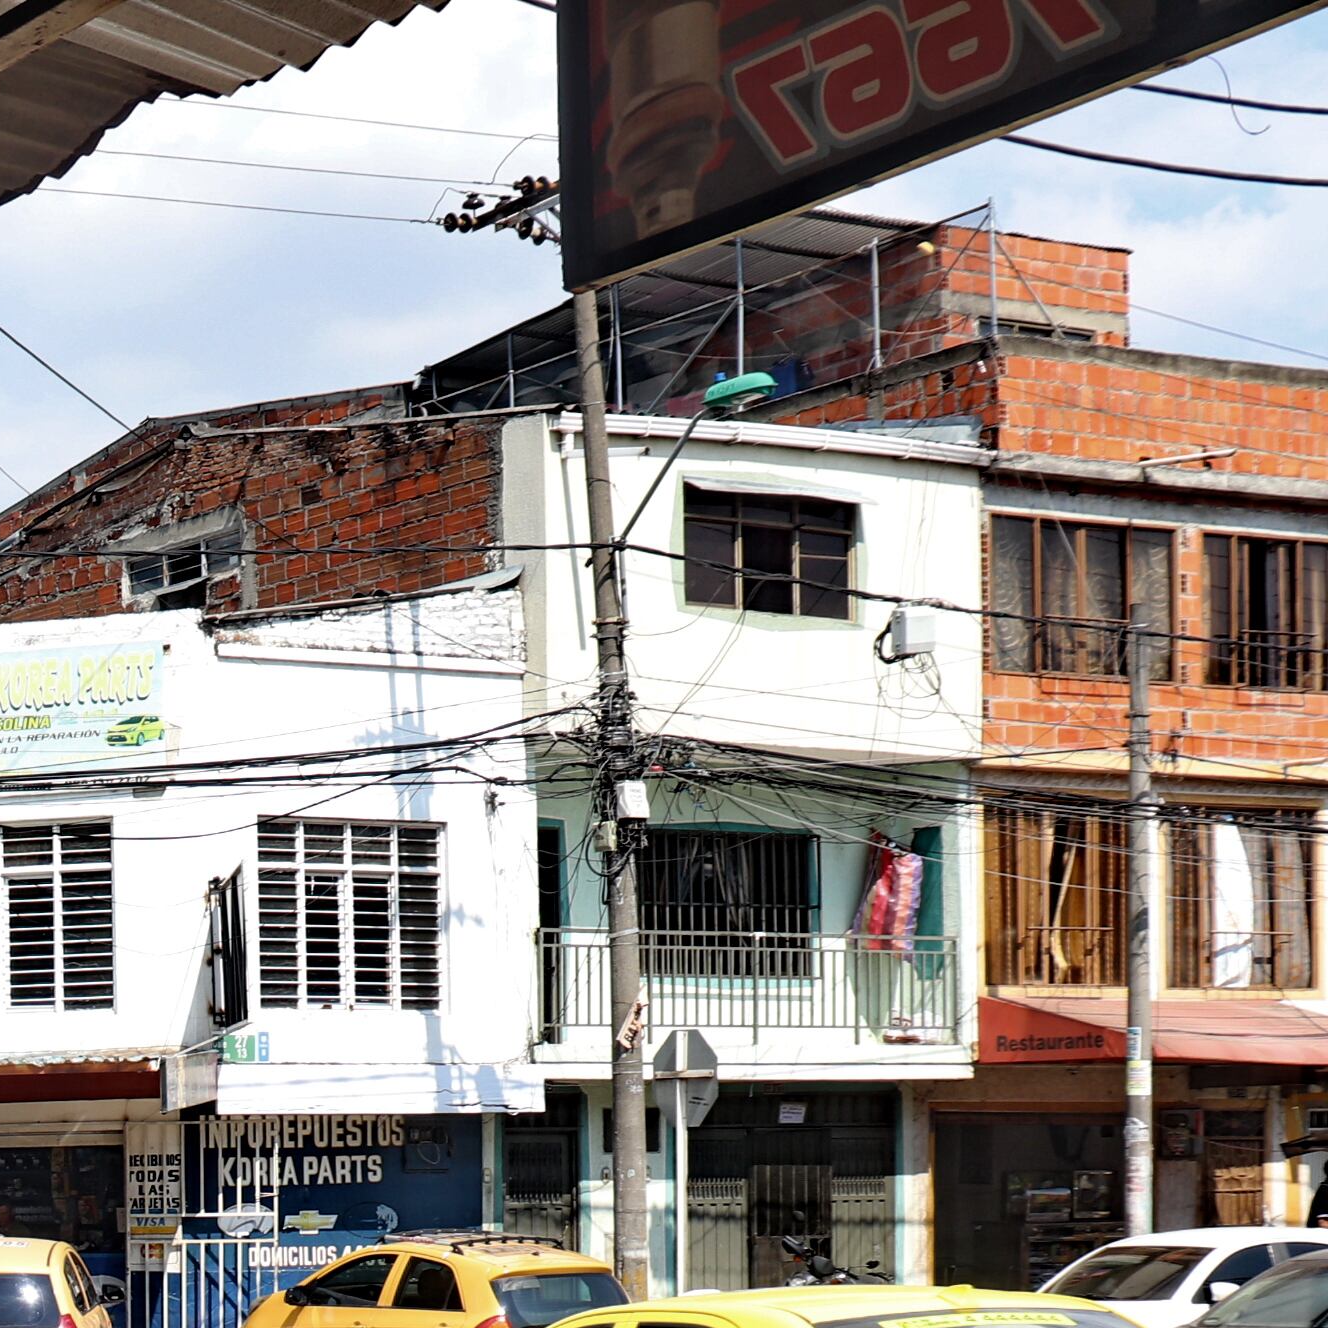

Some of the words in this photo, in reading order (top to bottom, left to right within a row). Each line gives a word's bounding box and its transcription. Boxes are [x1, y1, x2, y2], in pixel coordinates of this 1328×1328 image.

[77, 653, 155, 706] PARTS
[8, 735, 23, 744] LA
[235, 1035, 248, 1048] 27
[996, 1034, 1104, 1052] Restaurante
[222, 1155, 298, 1187] KOREA
[303, 1155, 382, 1185] PARTS
[138, 1184, 170, 1196] LAS
[135, 1217, 166, 1226] VISA
[249, 1247, 337, 1267] DOMICILIOS
